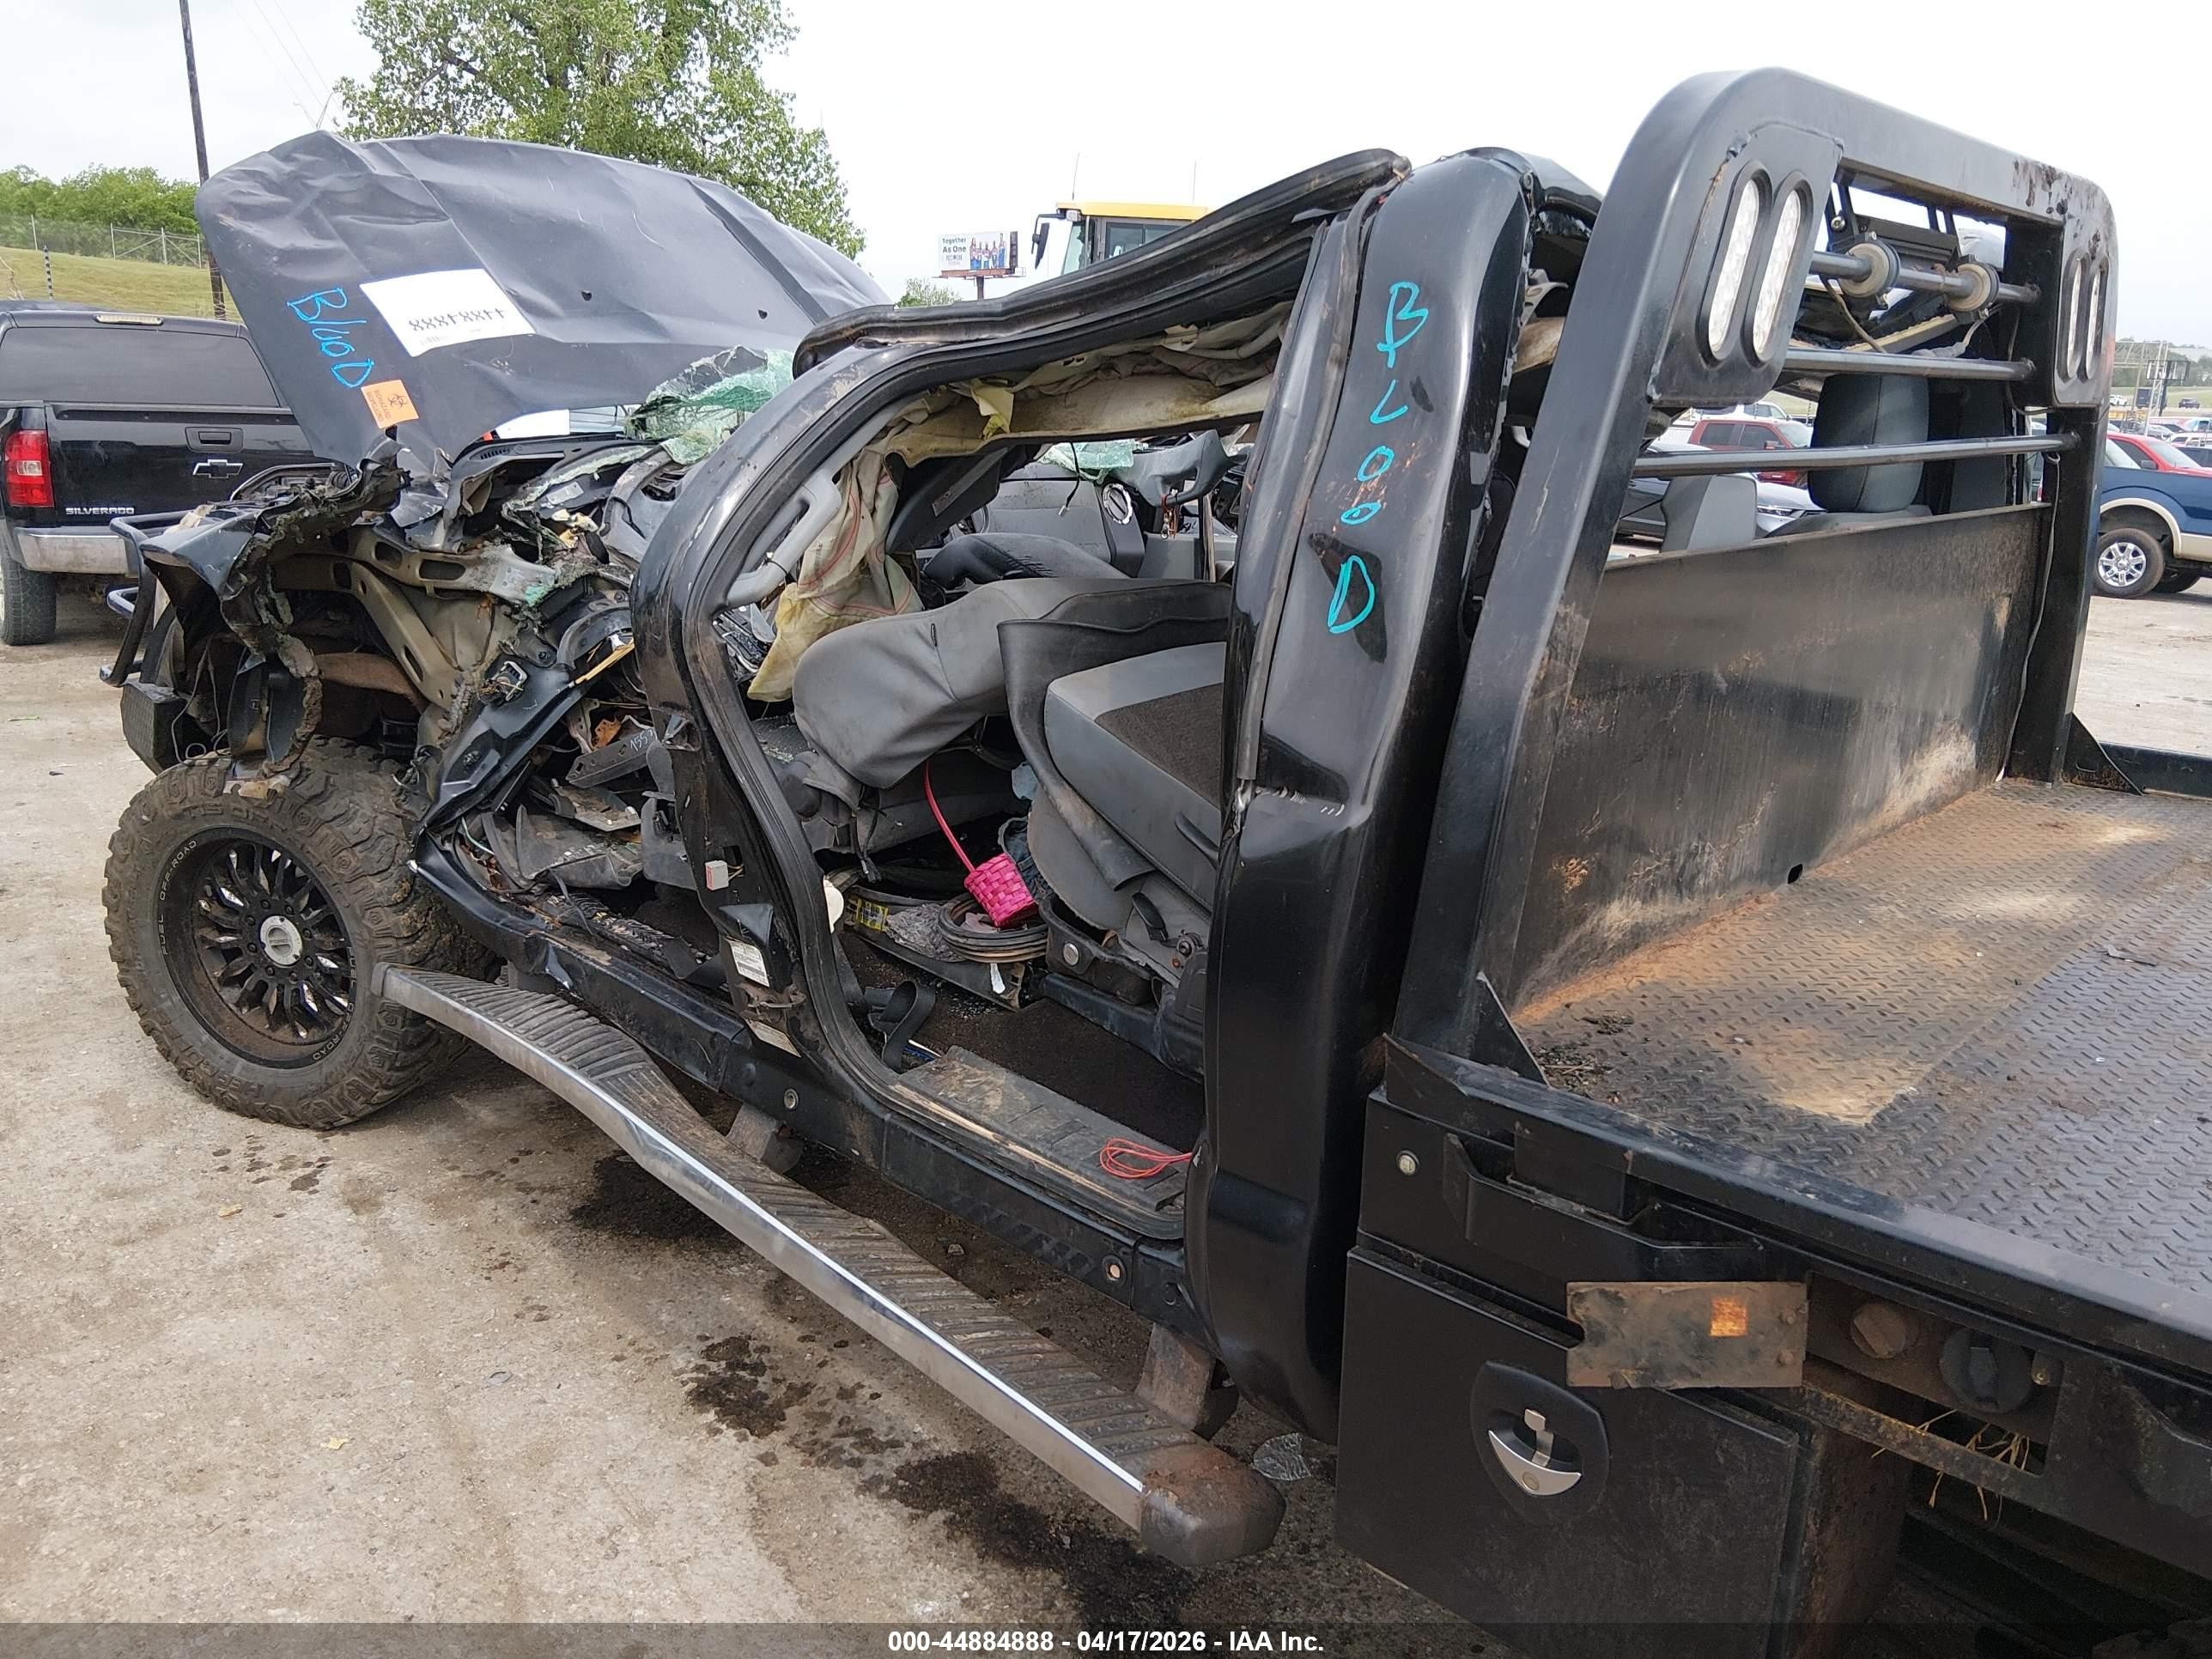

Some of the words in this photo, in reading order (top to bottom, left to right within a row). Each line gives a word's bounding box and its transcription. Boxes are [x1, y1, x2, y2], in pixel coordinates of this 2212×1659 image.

[942, 237, 967, 246] Together
[65, 507, 135, 515] SILVERADO
[159, 839, 198, 901] OFF-ROAD
[158, 915, 168, 956] FUEL
[312, 1000, 357, 1061] OFF-ROAD
